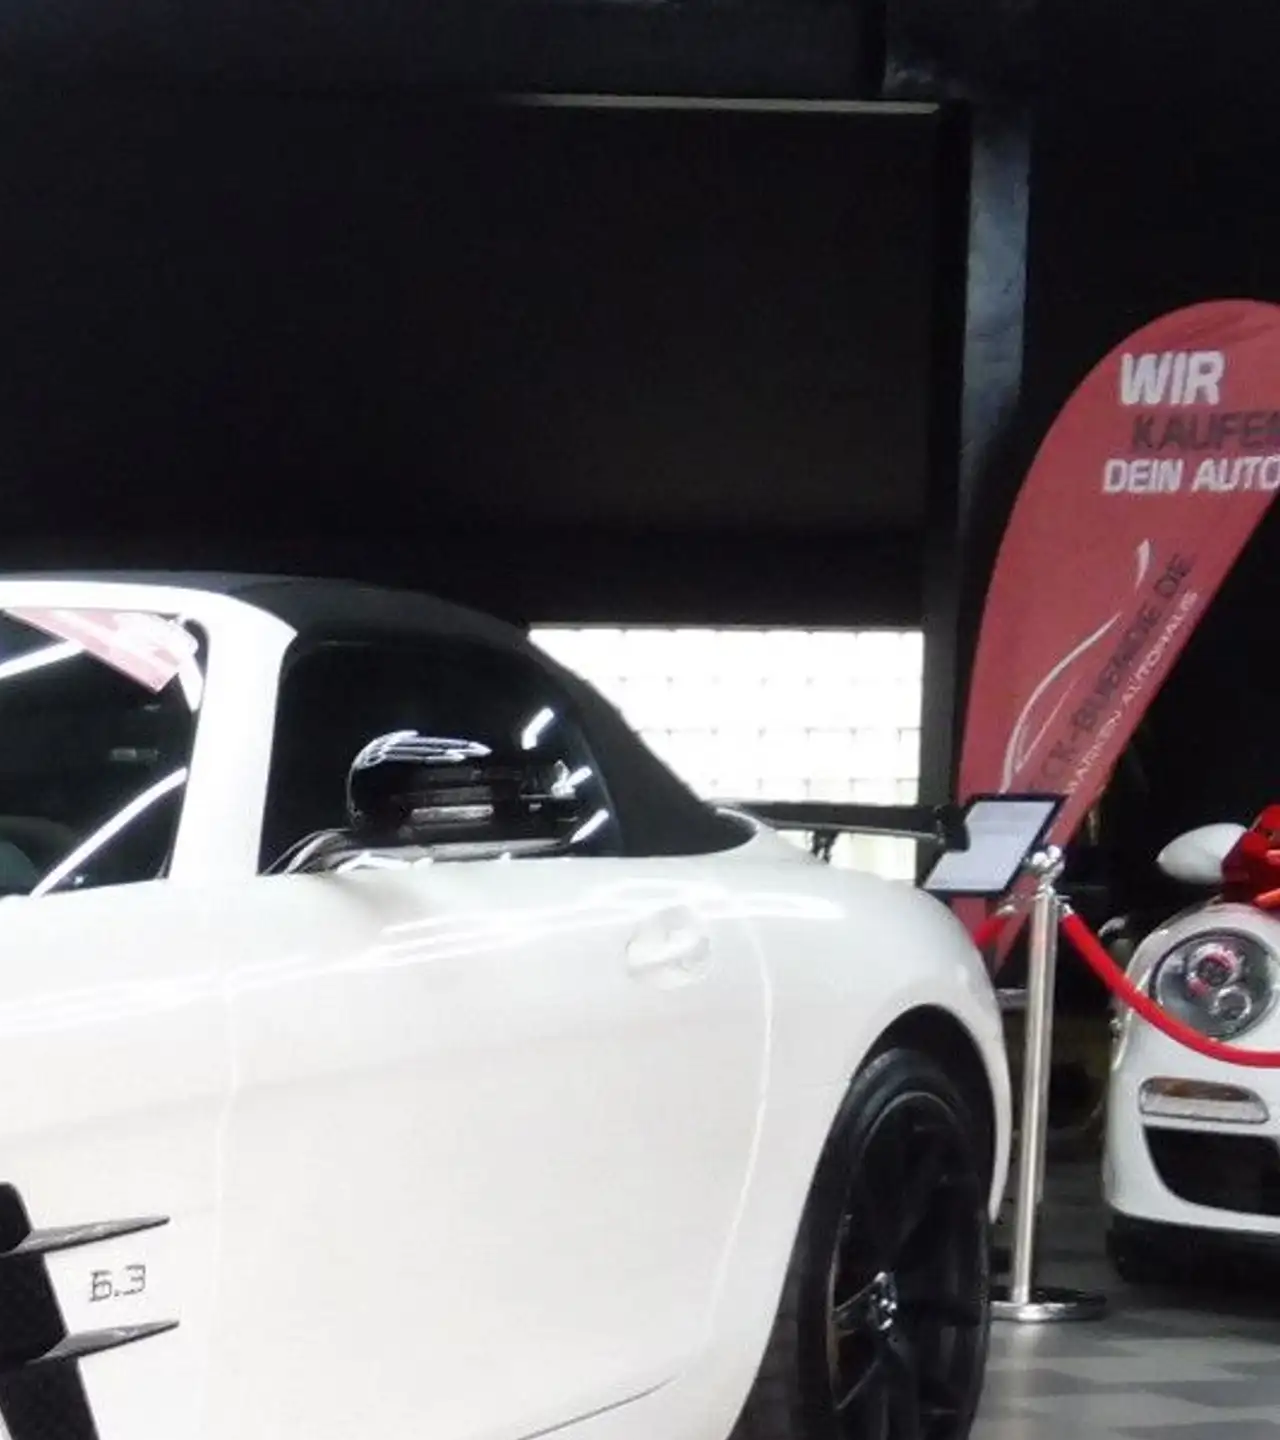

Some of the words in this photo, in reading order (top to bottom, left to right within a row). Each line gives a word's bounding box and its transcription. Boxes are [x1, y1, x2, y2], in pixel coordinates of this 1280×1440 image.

[1120, 351, 1224, 405] WIR
[1103, 457, 1185, 493] DEIN
[1192, 454, 1280, 492] AUTO
[90, 1264, 146, 1303] 6.3
